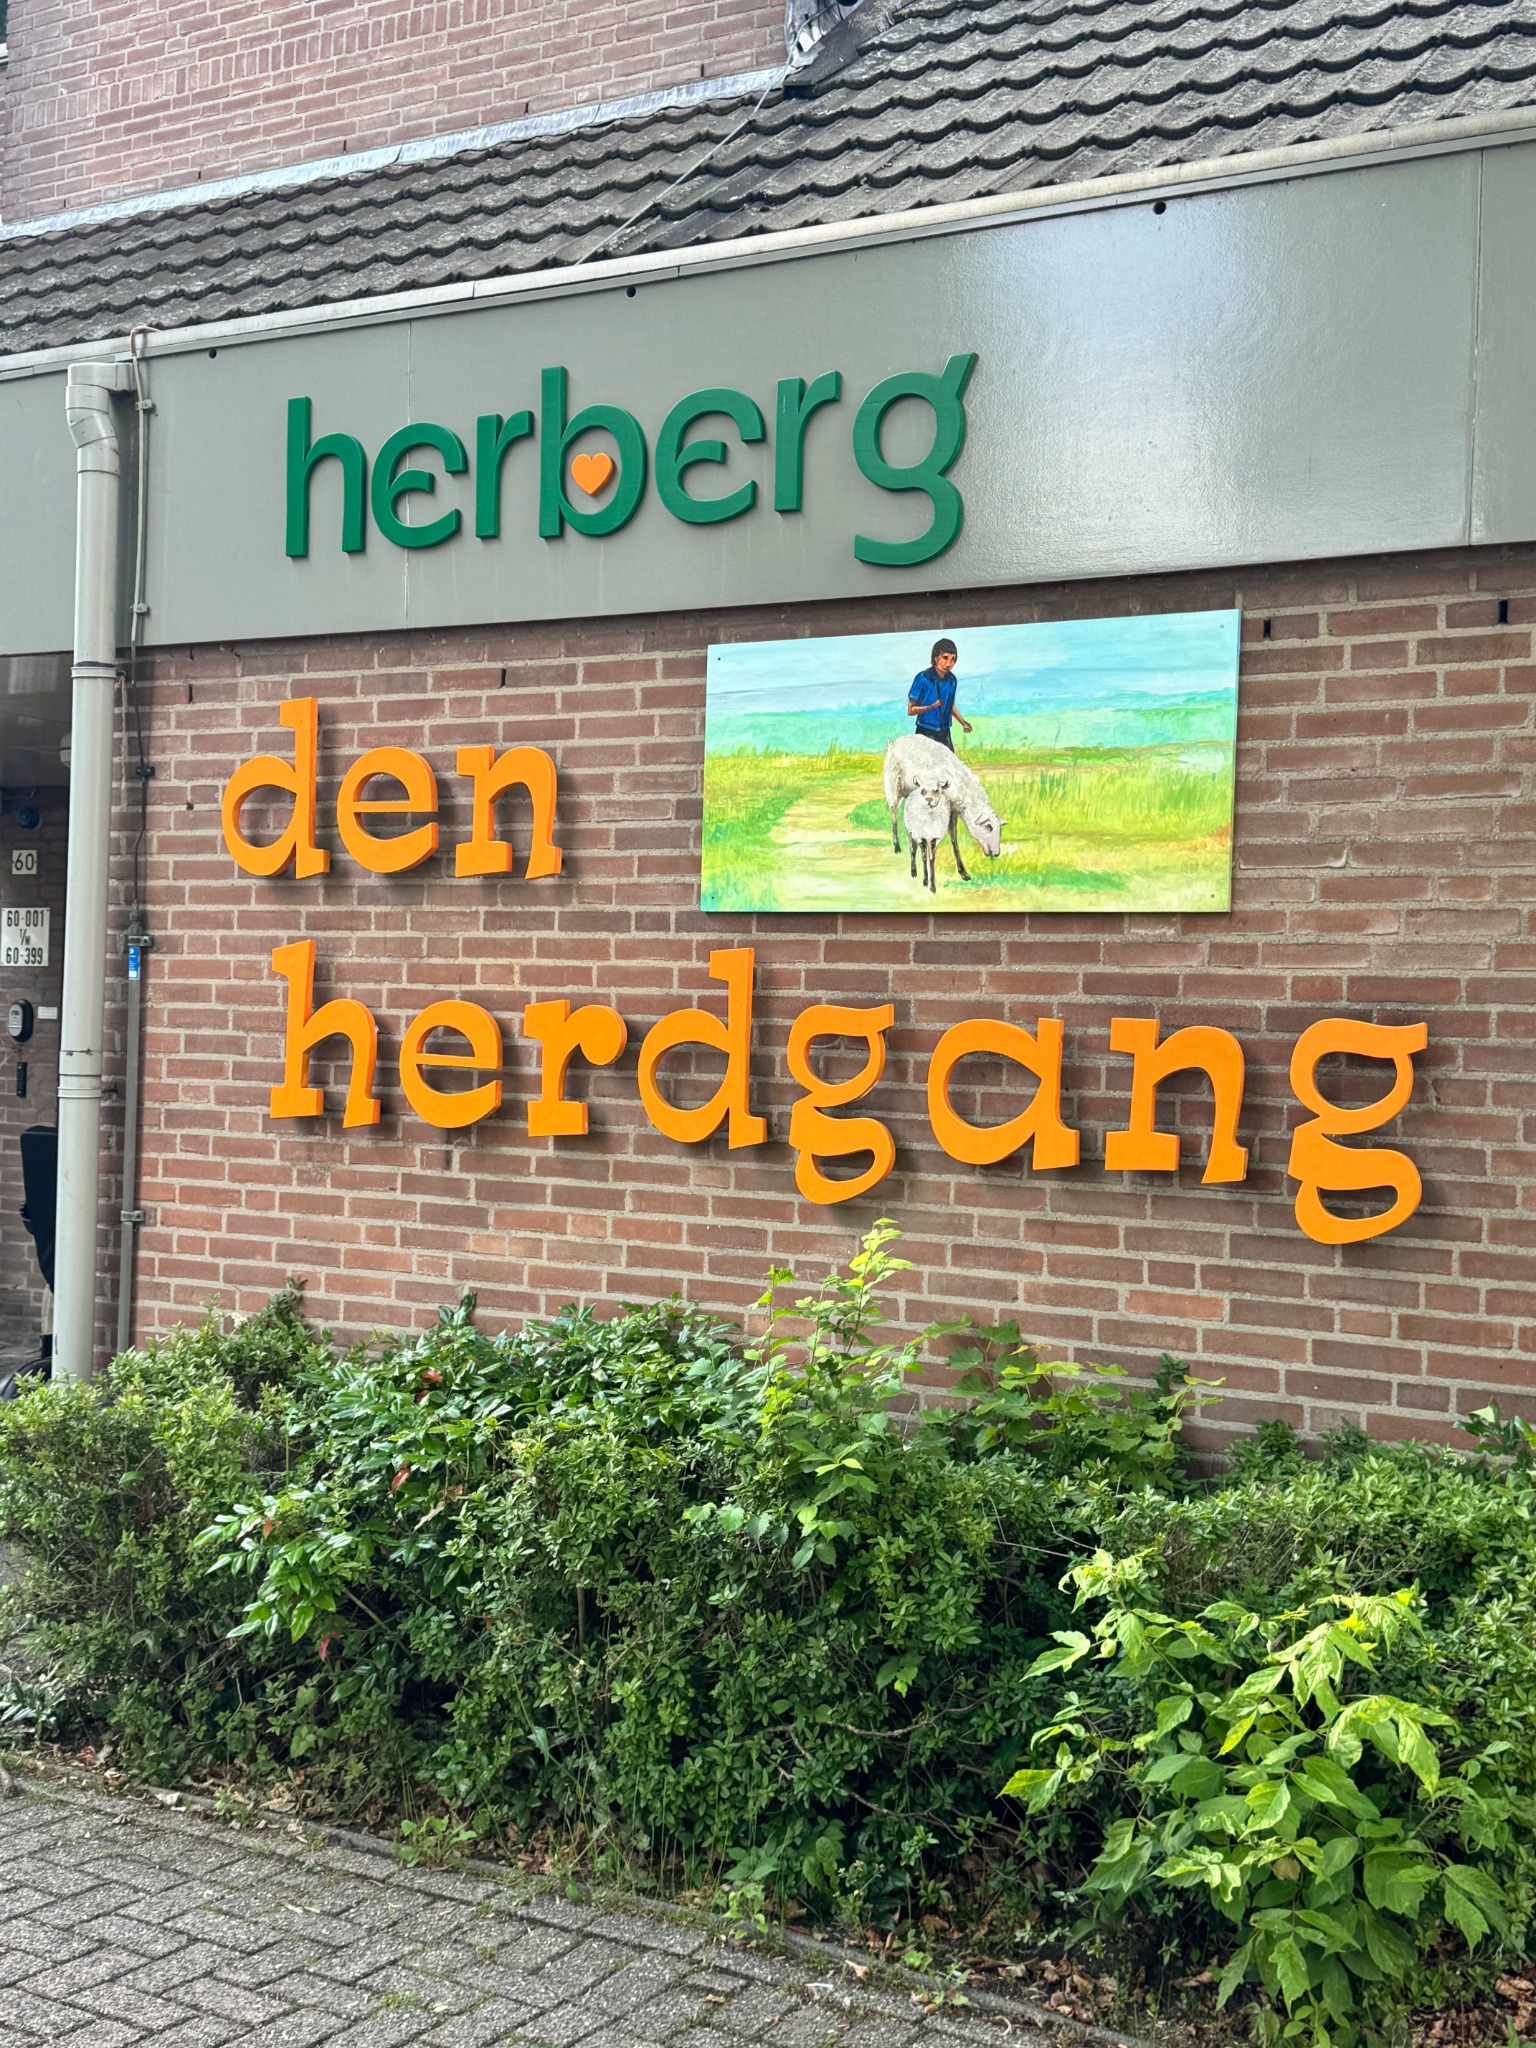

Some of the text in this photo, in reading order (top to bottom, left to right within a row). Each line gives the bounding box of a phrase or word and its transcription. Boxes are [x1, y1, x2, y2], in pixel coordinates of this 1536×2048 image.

[286, 353, 978, 569] herberg
[222, 696, 564, 880] den
[15, 852, 34, 871] 60
[6, 946, 43, 965] 60-399
[7, 910, 44, 927] 60-001
[269, 940, 1430, 1248] herdgang
